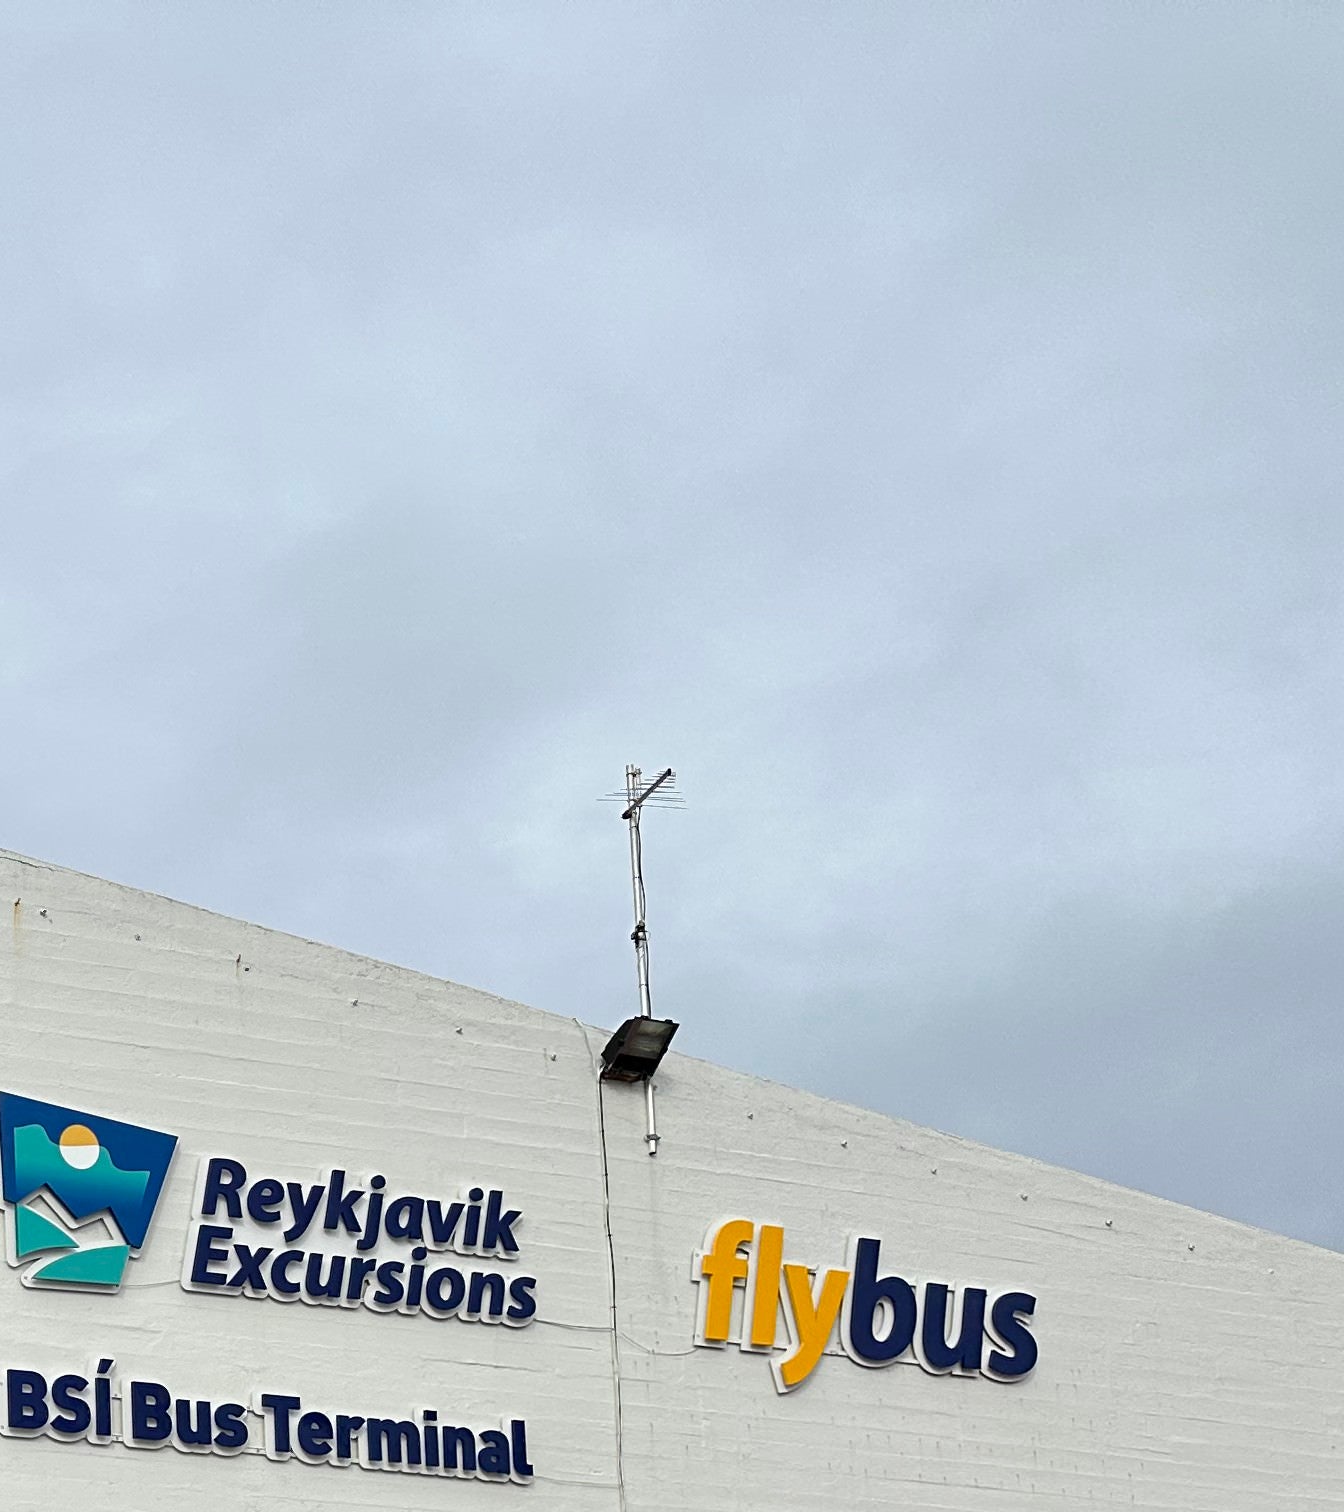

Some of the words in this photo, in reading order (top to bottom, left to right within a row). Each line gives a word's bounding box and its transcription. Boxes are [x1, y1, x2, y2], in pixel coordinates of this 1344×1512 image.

[201, 1158, 523, 1253] Reykjavik
[190, 1224, 538, 1322] Excursions
[702, 1220, 1039, 1386] flybus
[7, 1358, 114, 1437] BSÍ
[130, 1381, 249, 1448] Bus
[262, 1393, 534, 1476] Terminal
